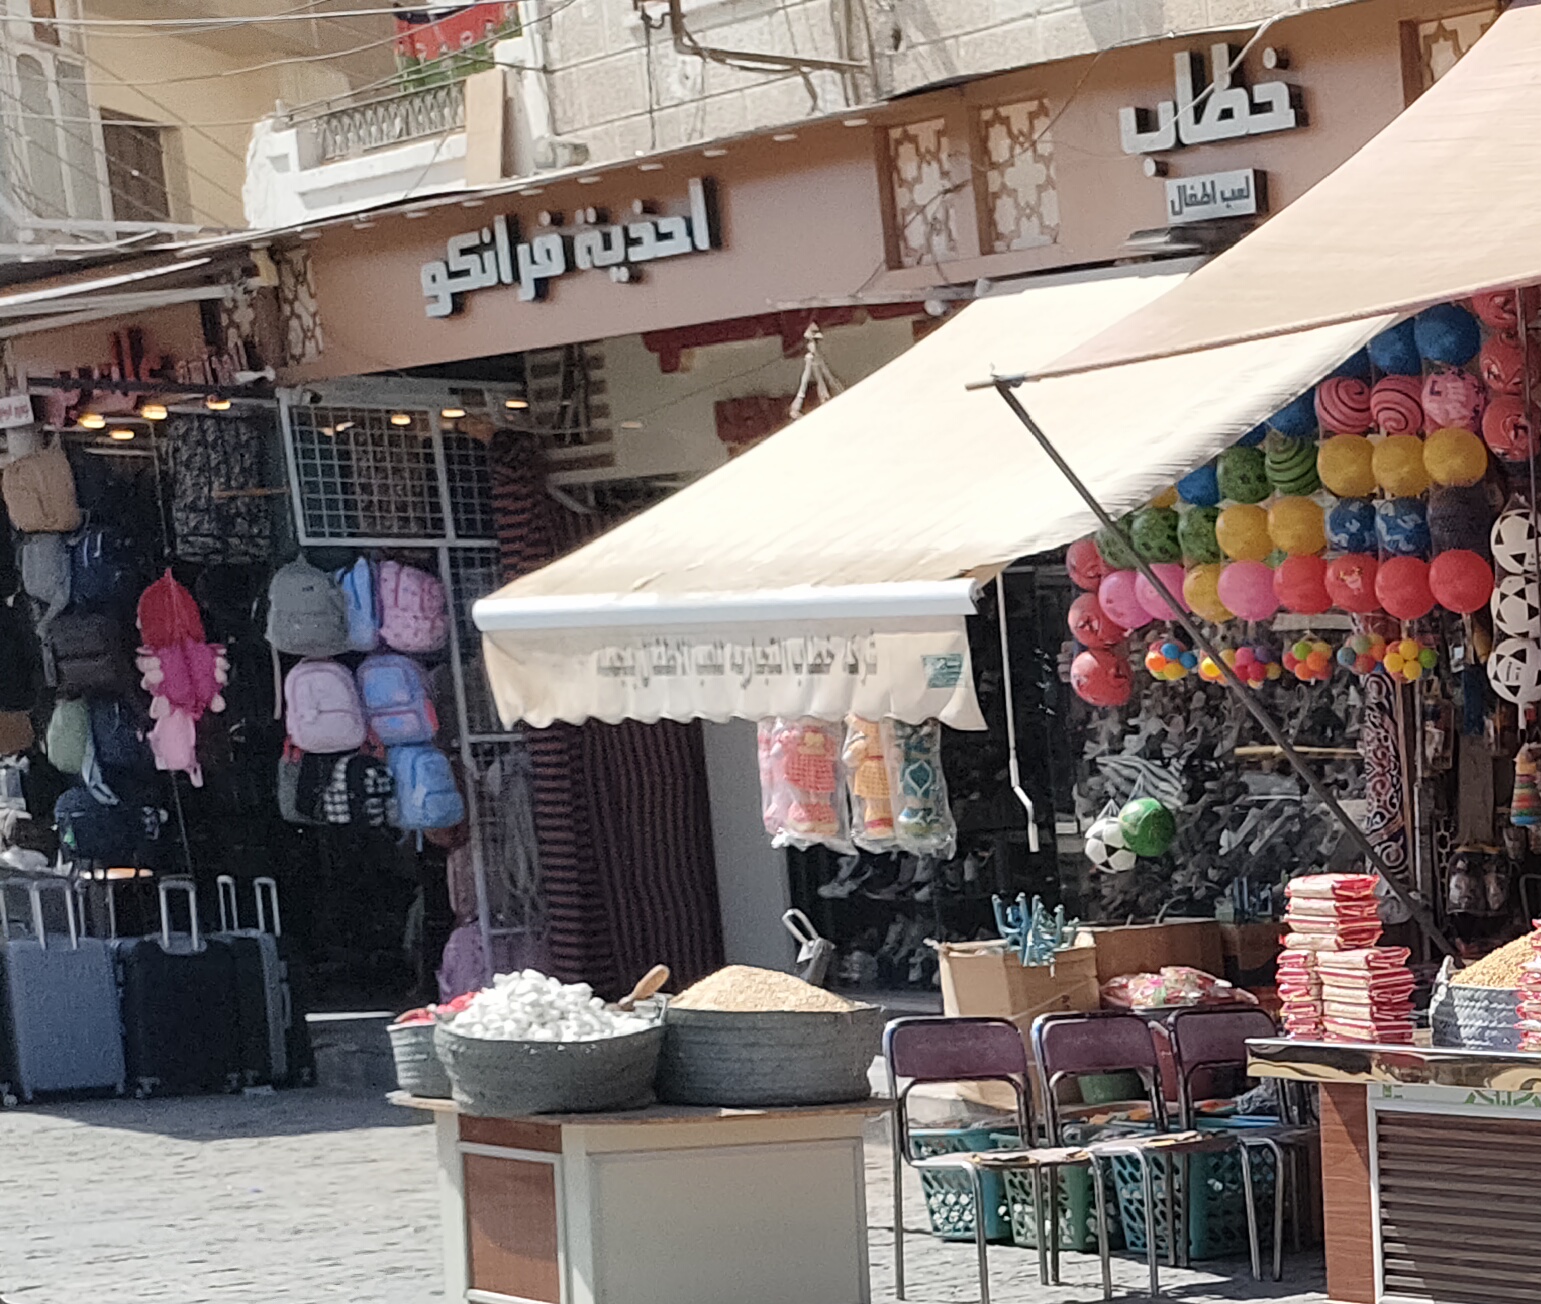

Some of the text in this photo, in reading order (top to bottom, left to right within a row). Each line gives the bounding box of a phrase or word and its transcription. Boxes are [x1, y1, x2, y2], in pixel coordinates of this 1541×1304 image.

[1118, 42, 1297, 179] خطاب
[420, 177, 713, 318] احذية فرانكو
[1219, 175, 1251, 210] لعب
